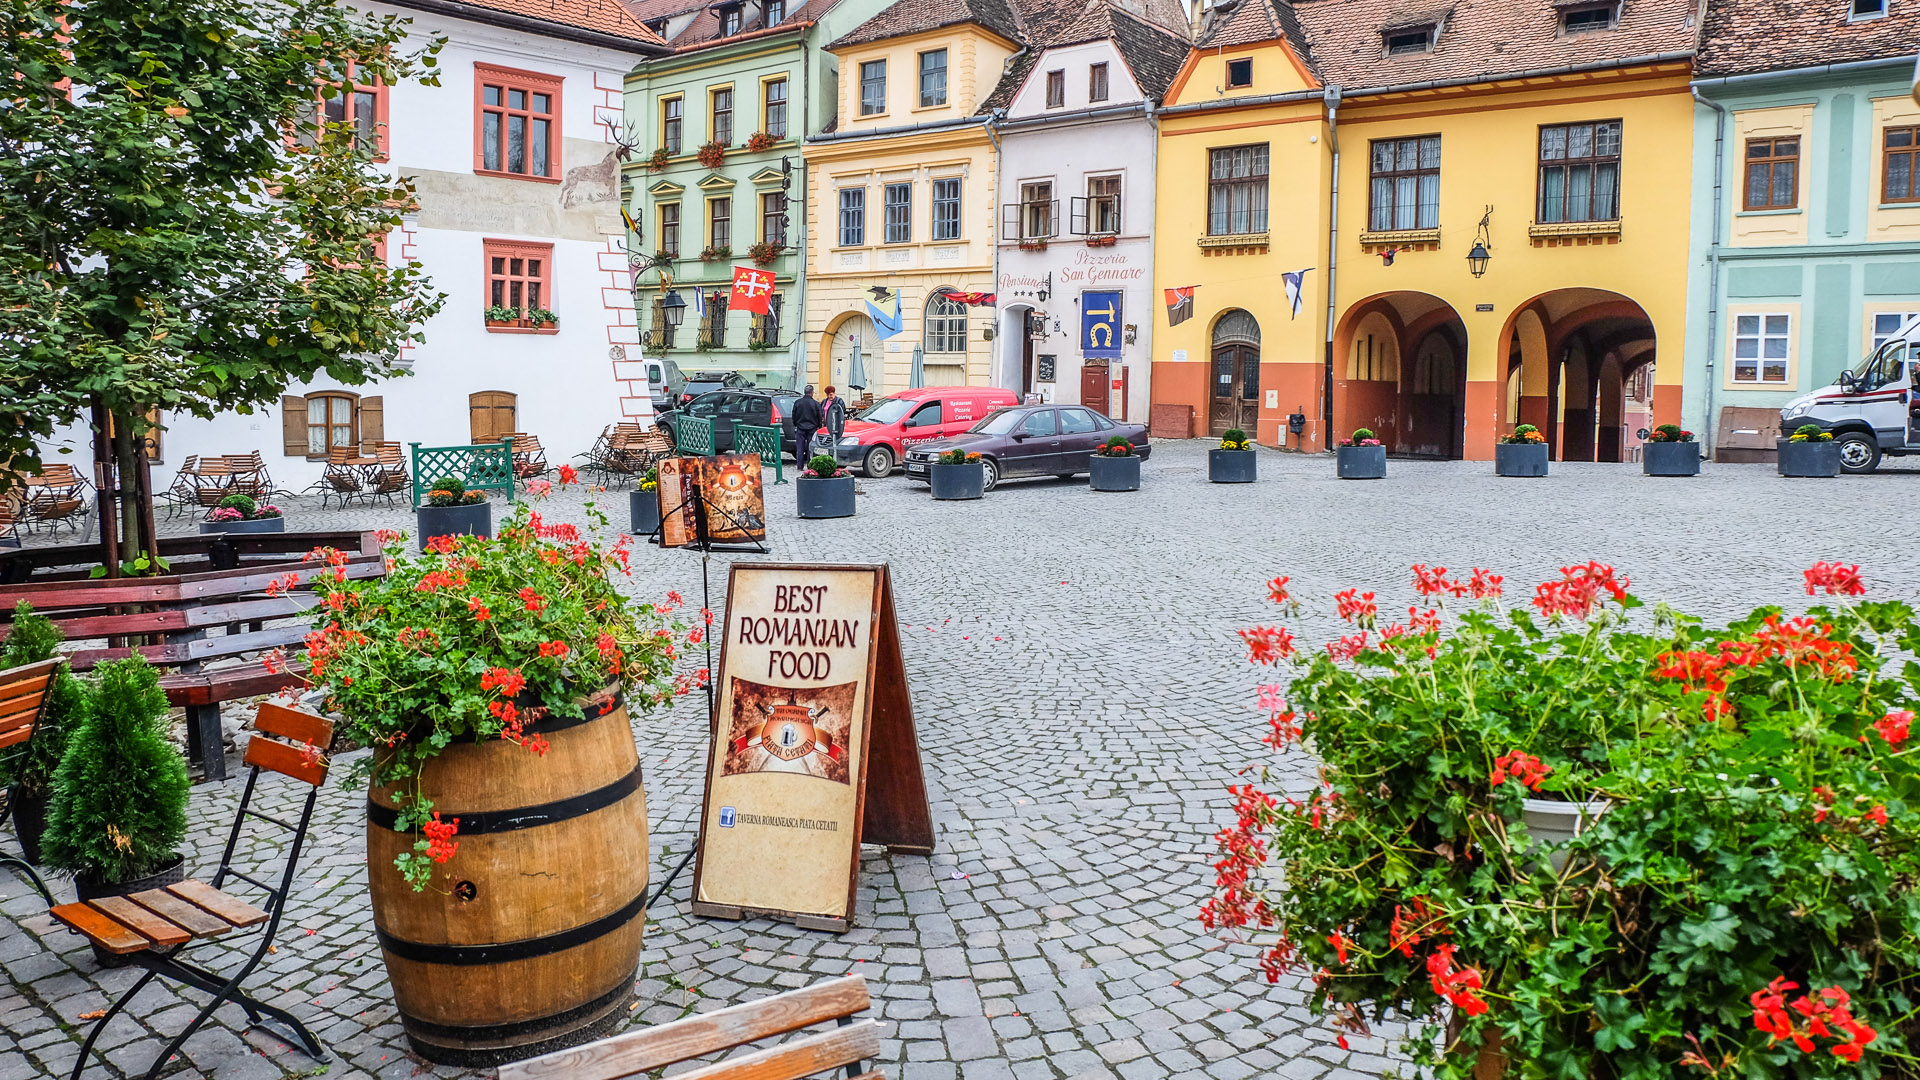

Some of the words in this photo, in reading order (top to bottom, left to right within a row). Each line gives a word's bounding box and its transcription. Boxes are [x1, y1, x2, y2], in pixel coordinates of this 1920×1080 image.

[1075, 248, 1128, 265] Pizzeria
[1060, 267, 1084, 283] San
[1087, 266, 1145, 285] Gennaro
[774, 585, 828, 613] BEST
[768, 650, 831, 681] FOOD
[737, 813, 761, 825] TAVERNA
[762, 815, 799, 828] ROMANEASCA
[800, 818, 815, 830] PIATA
